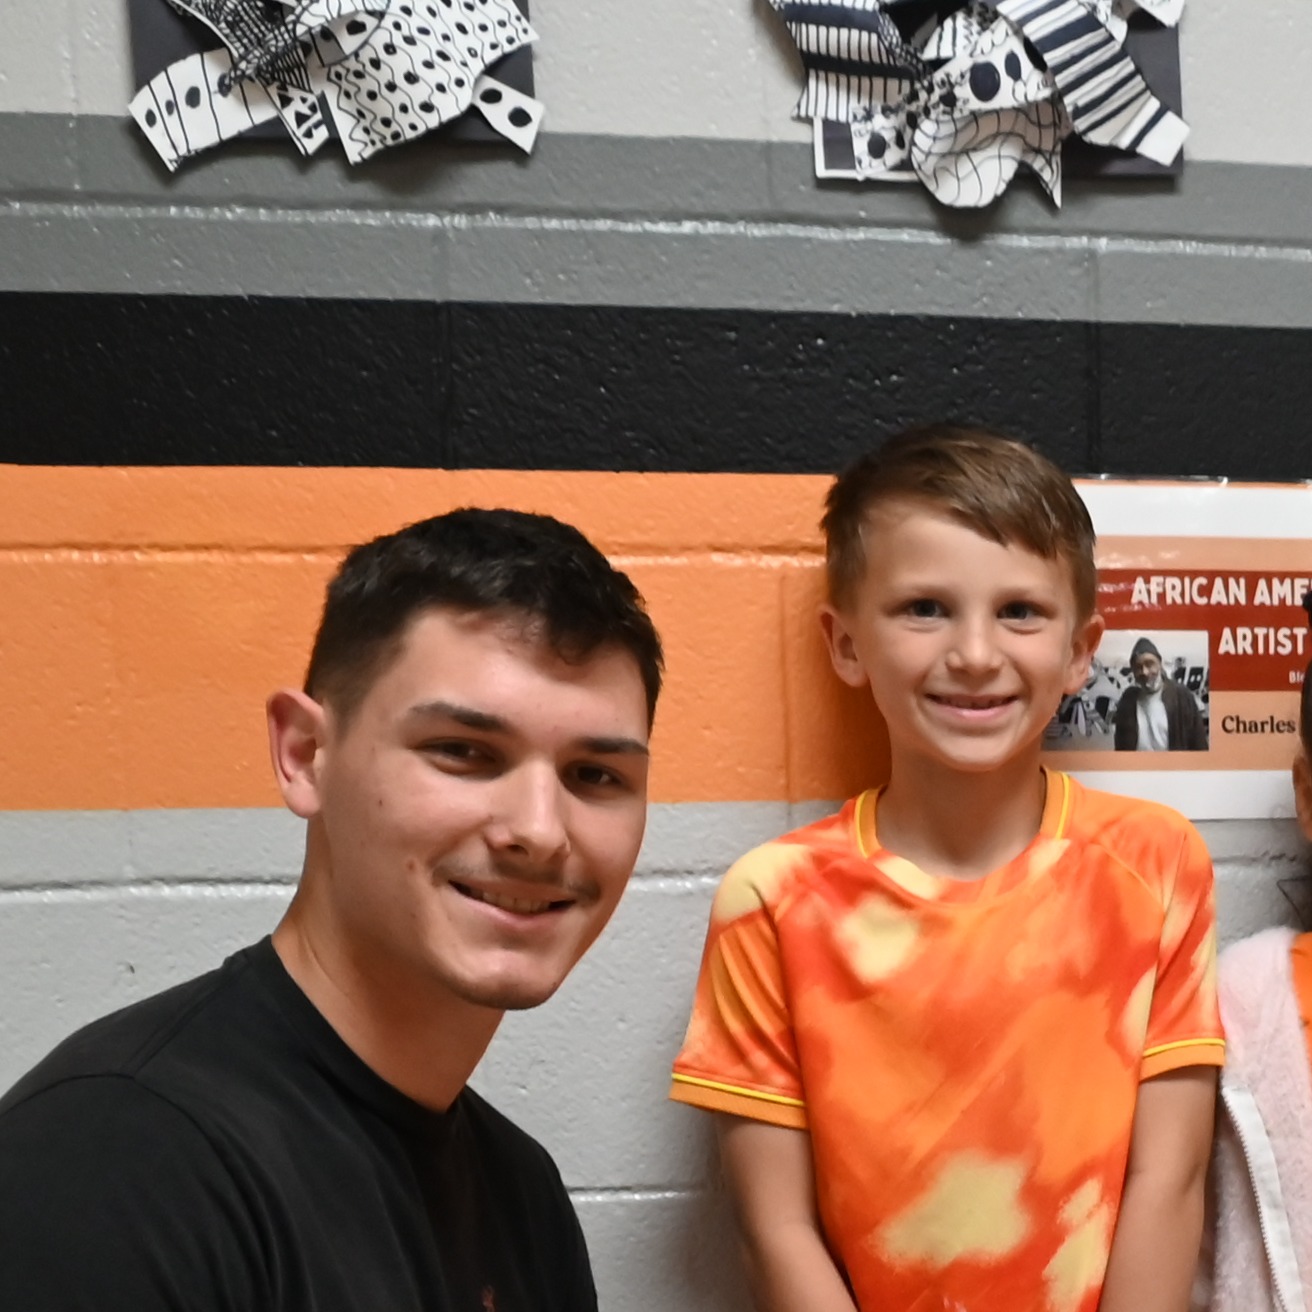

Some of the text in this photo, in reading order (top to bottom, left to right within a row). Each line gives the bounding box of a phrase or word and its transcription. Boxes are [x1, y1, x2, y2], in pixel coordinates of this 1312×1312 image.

[1131, 575, 1247, 606] AFRICAN
[1217, 626, 1307, 656] ARTIST
[1221, 715, 1296, 734] Charles
